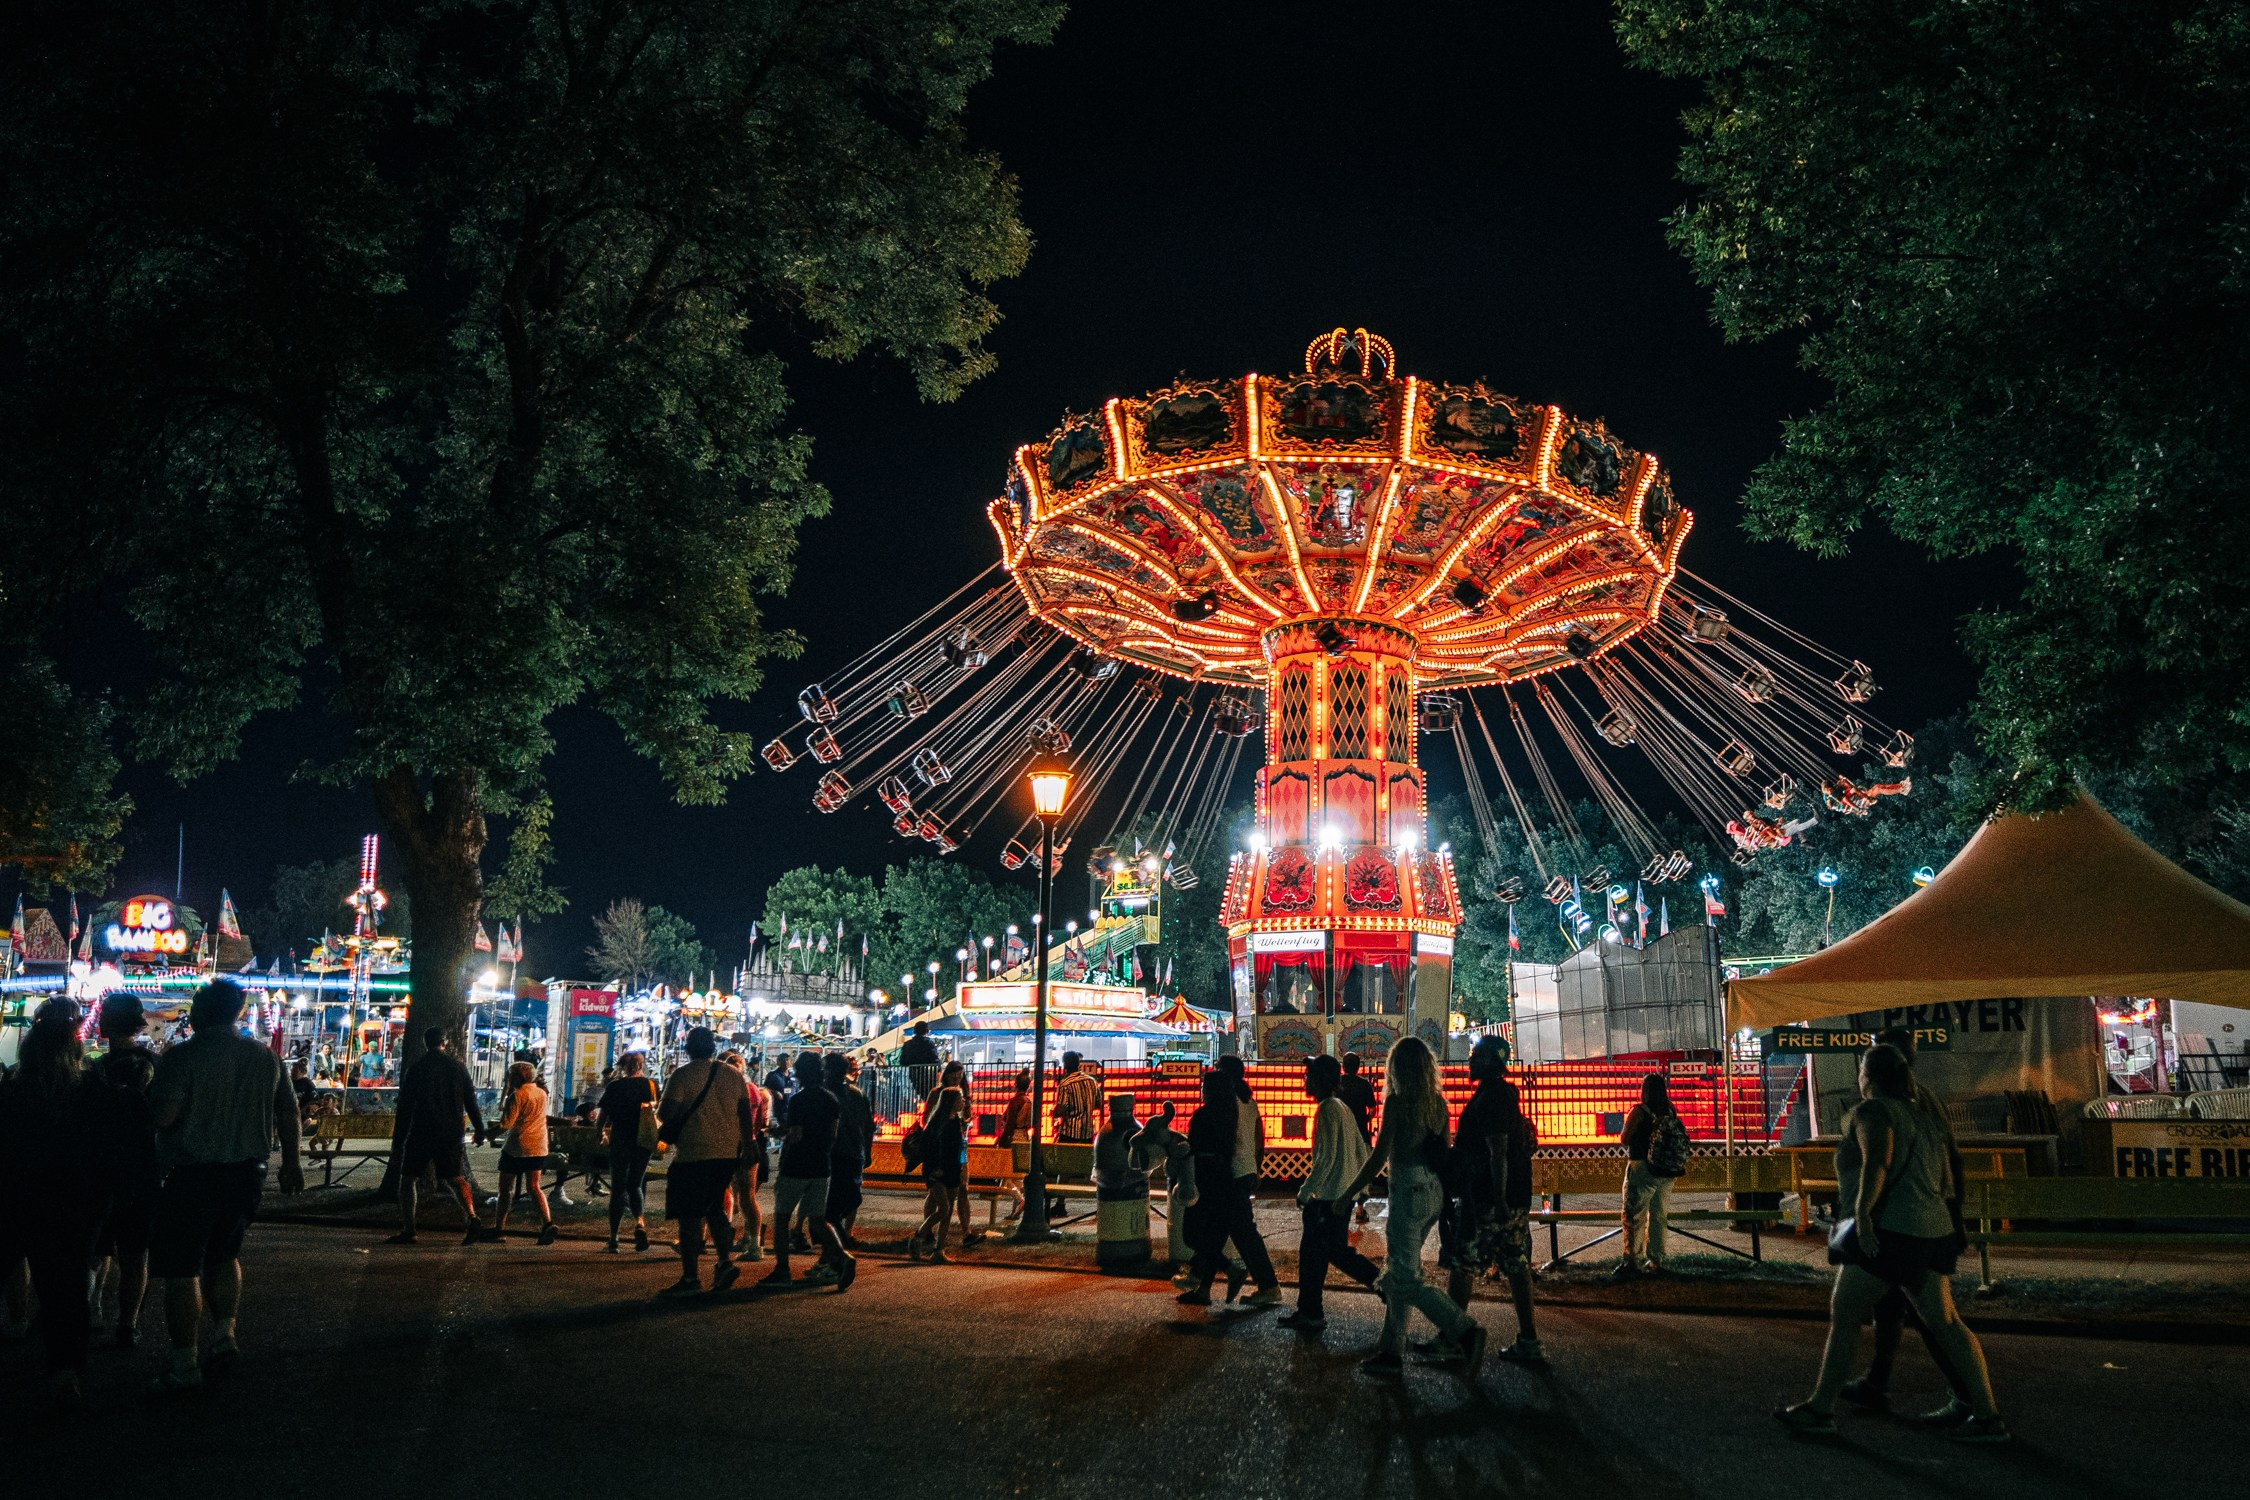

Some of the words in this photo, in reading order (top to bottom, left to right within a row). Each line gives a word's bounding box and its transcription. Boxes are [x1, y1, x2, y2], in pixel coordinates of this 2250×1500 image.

[124, 900, 171, 930] BIG
[106, 924, 188, 953] BAMBOO
[579, 1002, 610, 1013] kidway
[1884, 1001, 2025, 1032] PRAYER
[1778, 1031, 1824, 1048] FREE
[1673, 1064, 1704, 1072] EXIT
[2117, 1148, 2191, 1177] FREE
